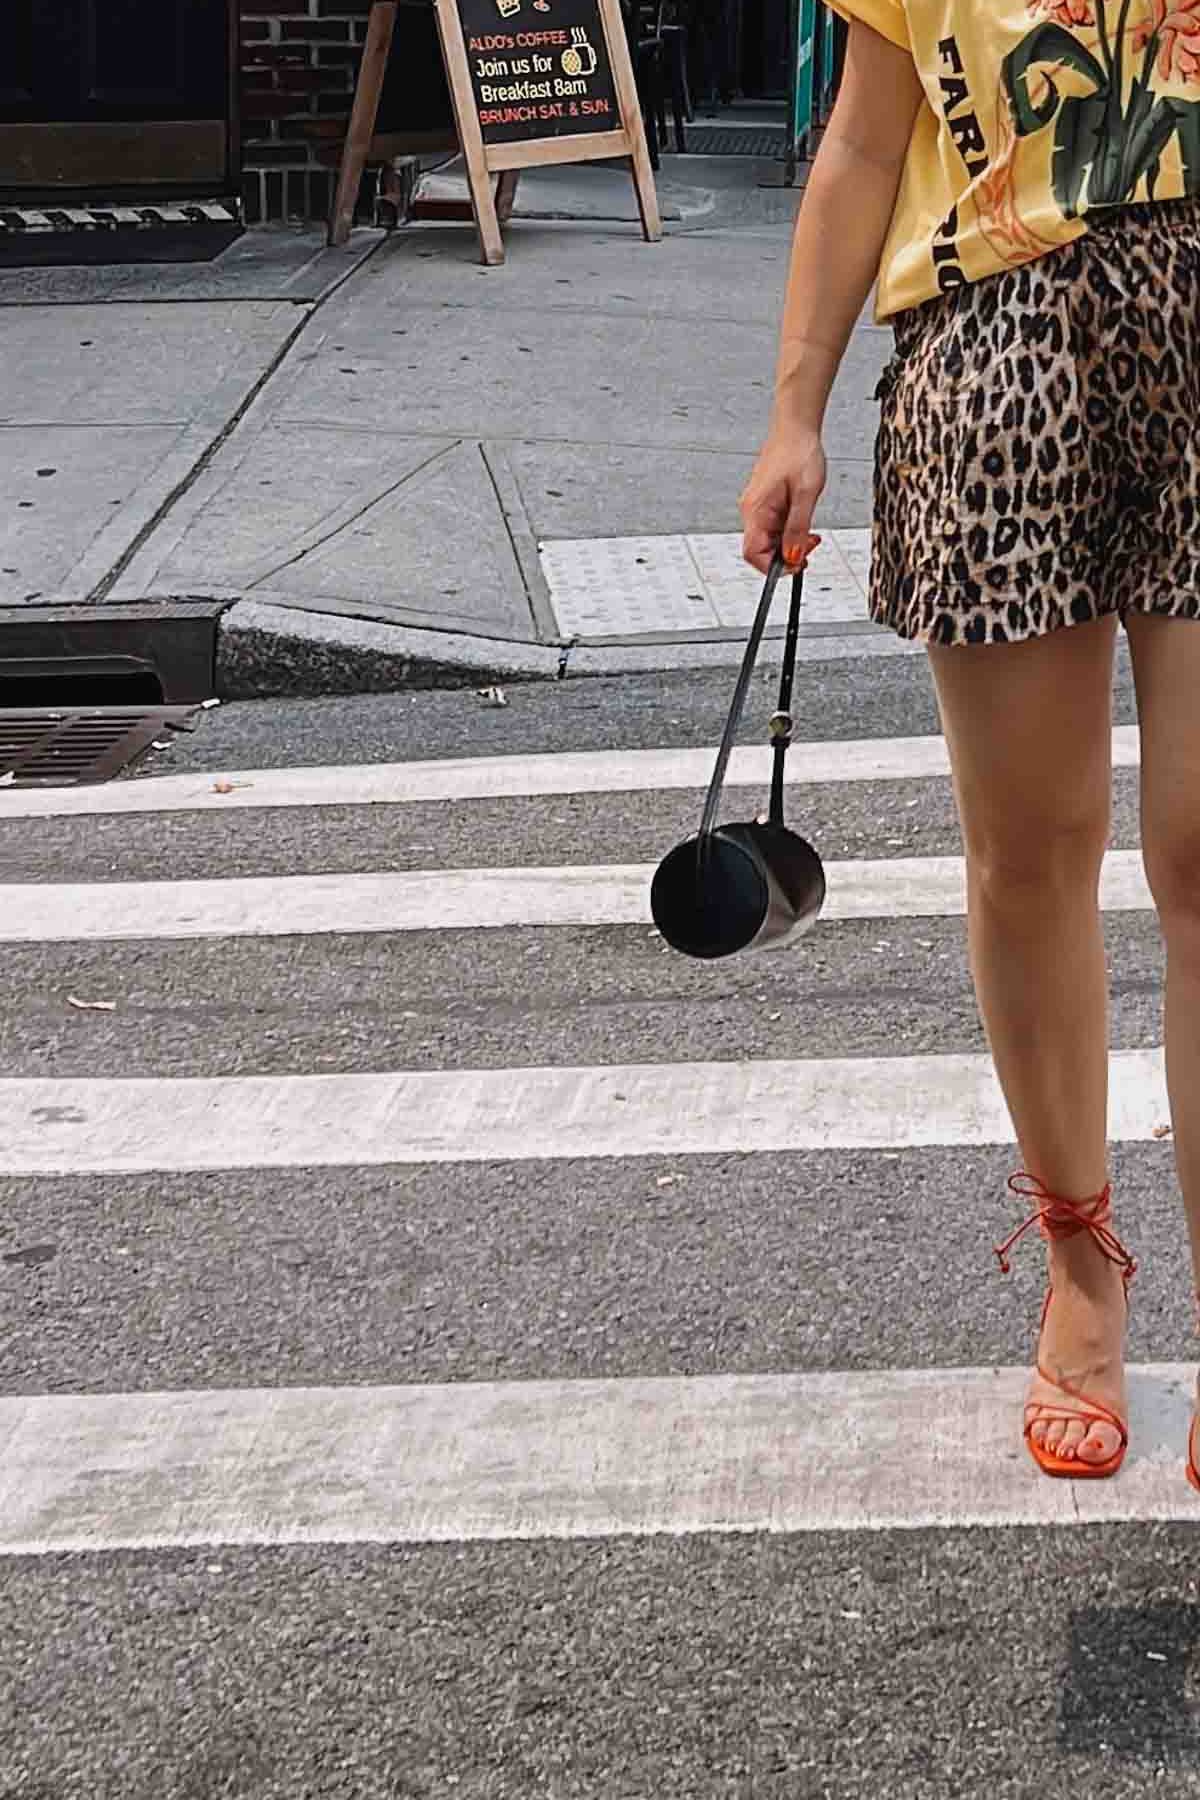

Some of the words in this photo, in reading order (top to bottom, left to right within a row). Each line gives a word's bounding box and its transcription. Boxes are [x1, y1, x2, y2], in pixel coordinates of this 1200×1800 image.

[516, 30, 568, 46] COFFEE
[476, 57, 508, 77] Join
[511, 59, 530, 75] us
[532, 54, 552, 72] for
[480, 81, 552, 103] Breakfast
[554, 79, 587, 96] 8am
[480, 106, 537, 125] BRUNCH
[569, 102, 578, 117] &
